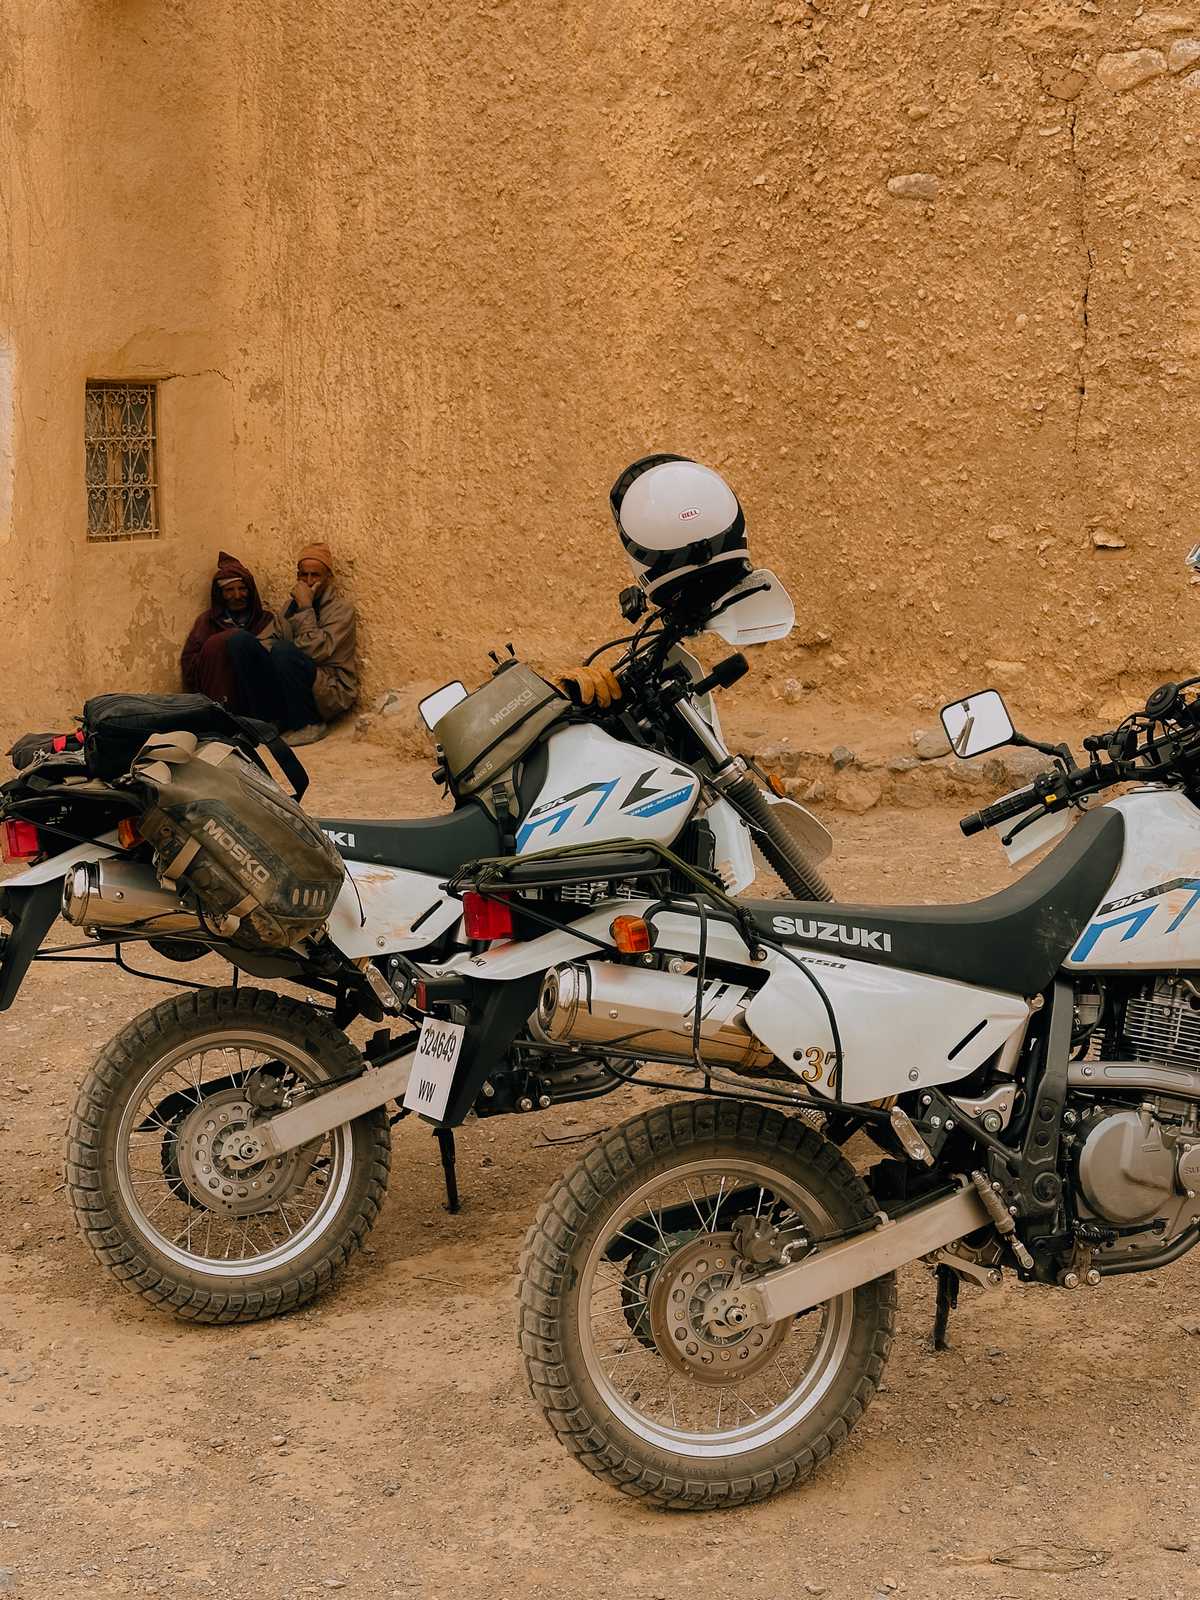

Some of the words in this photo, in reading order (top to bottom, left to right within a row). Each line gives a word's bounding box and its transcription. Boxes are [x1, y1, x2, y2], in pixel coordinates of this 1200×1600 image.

[681, 509, 698, 519] BELL
[489, 690, 533, 725] MOSKO
[203, 818, 271, 884] MOSKO
[772, 915, 892, 952] SUZUKI
[420, 1025, 457, 1063] 324649
[801, 1046, 845, 1088] 37
[418, 1079, 437, 1103] WW
